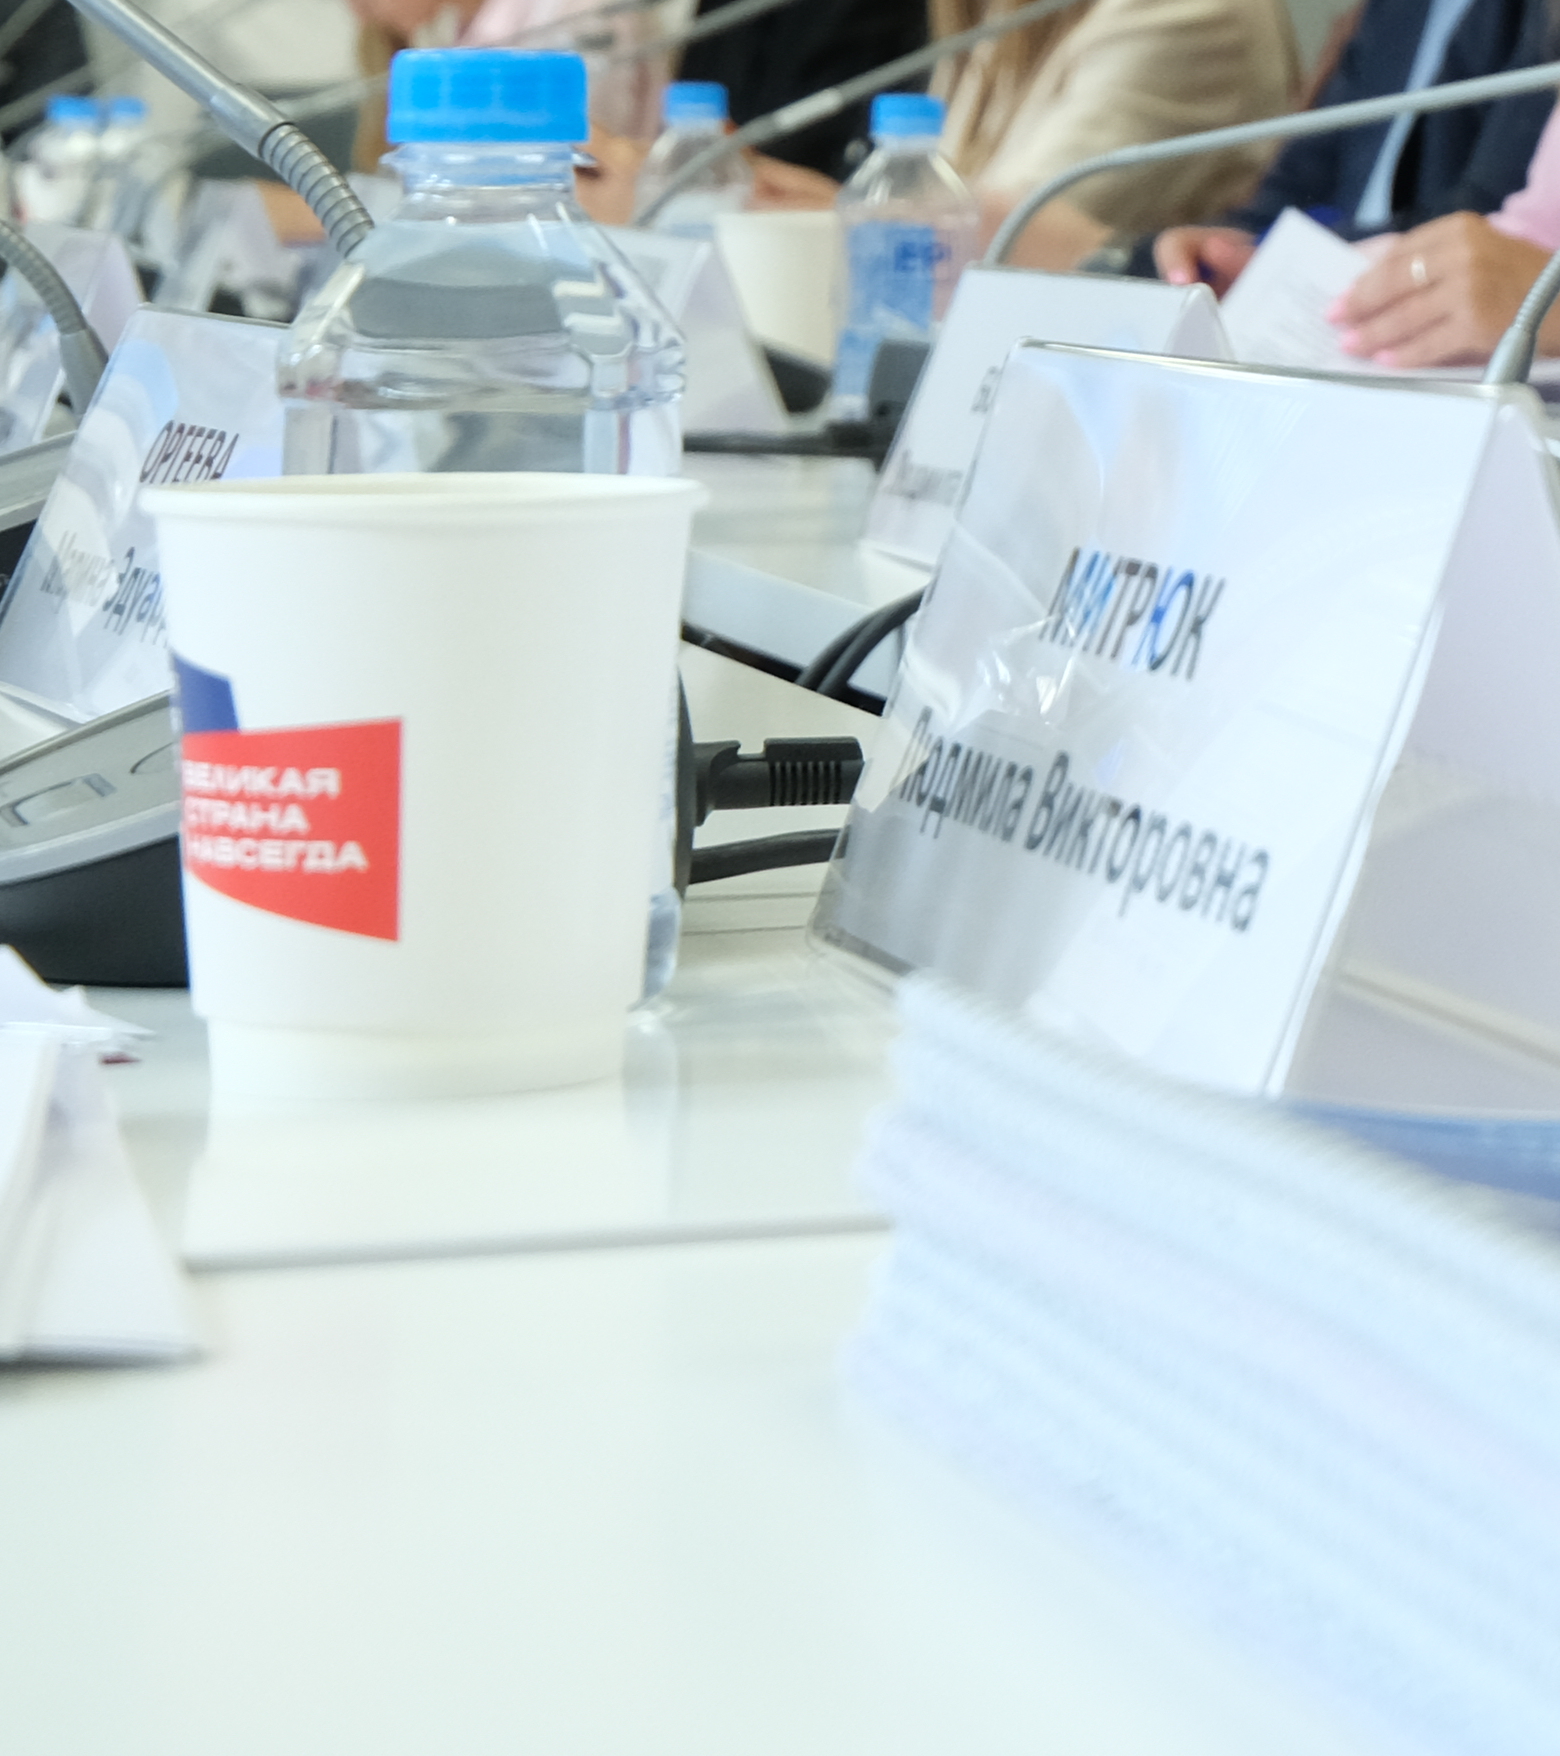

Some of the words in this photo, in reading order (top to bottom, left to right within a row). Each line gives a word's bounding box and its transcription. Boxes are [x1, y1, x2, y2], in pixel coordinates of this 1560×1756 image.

[1039, 546, 1227, 681] МИТРЮК
[890, 706, 1034, 840] Людмила
[1024, 750, 1271, 934] Викторовна
